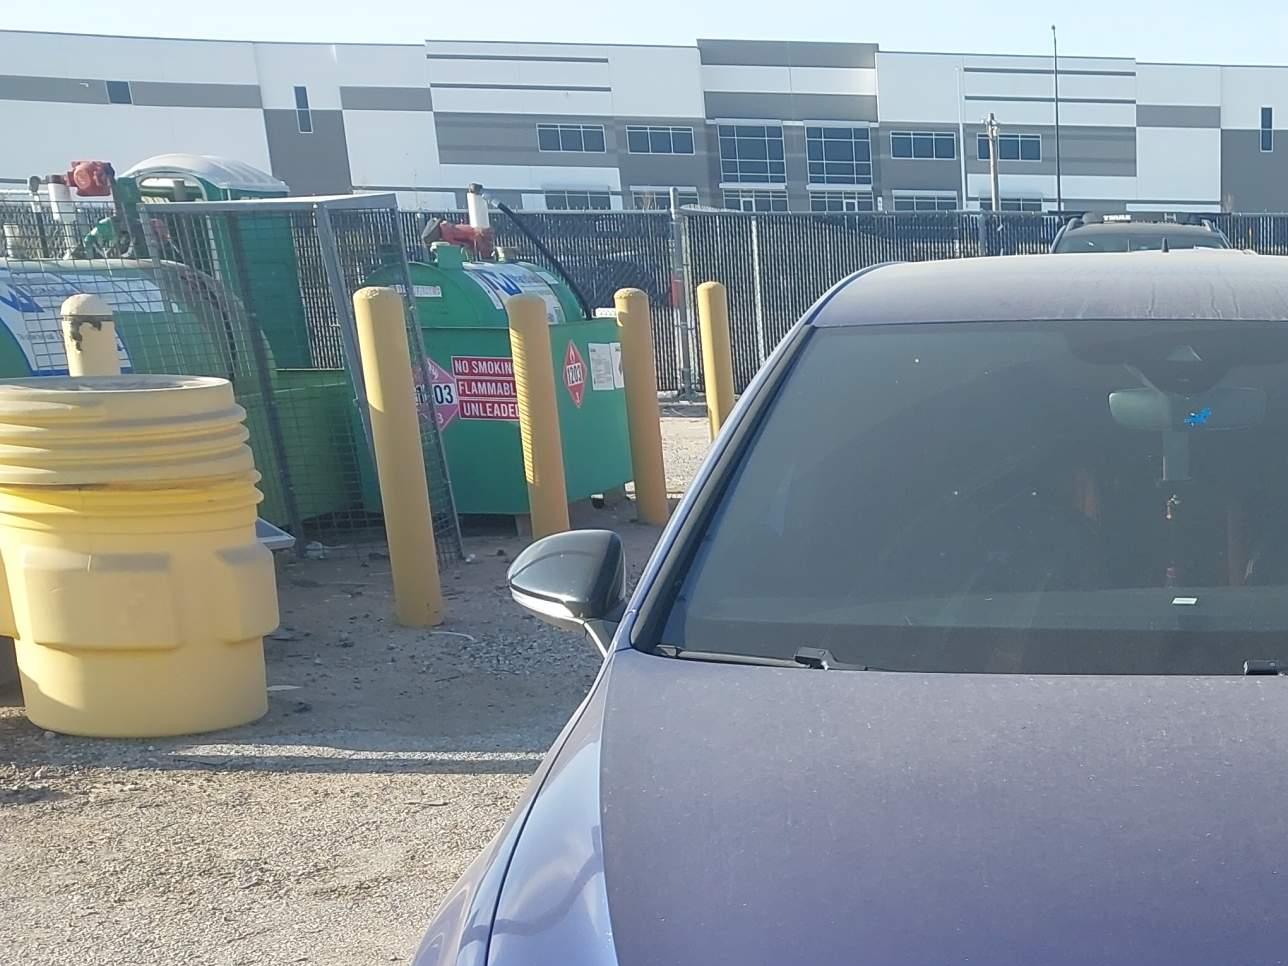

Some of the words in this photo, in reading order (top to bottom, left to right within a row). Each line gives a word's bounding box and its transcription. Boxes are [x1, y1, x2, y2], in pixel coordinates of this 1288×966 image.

[454, 359, 469, 373] NO
[471, 360, 513, 375] SMOKIN
[458, 380, 516, 396] FLAMMABL
